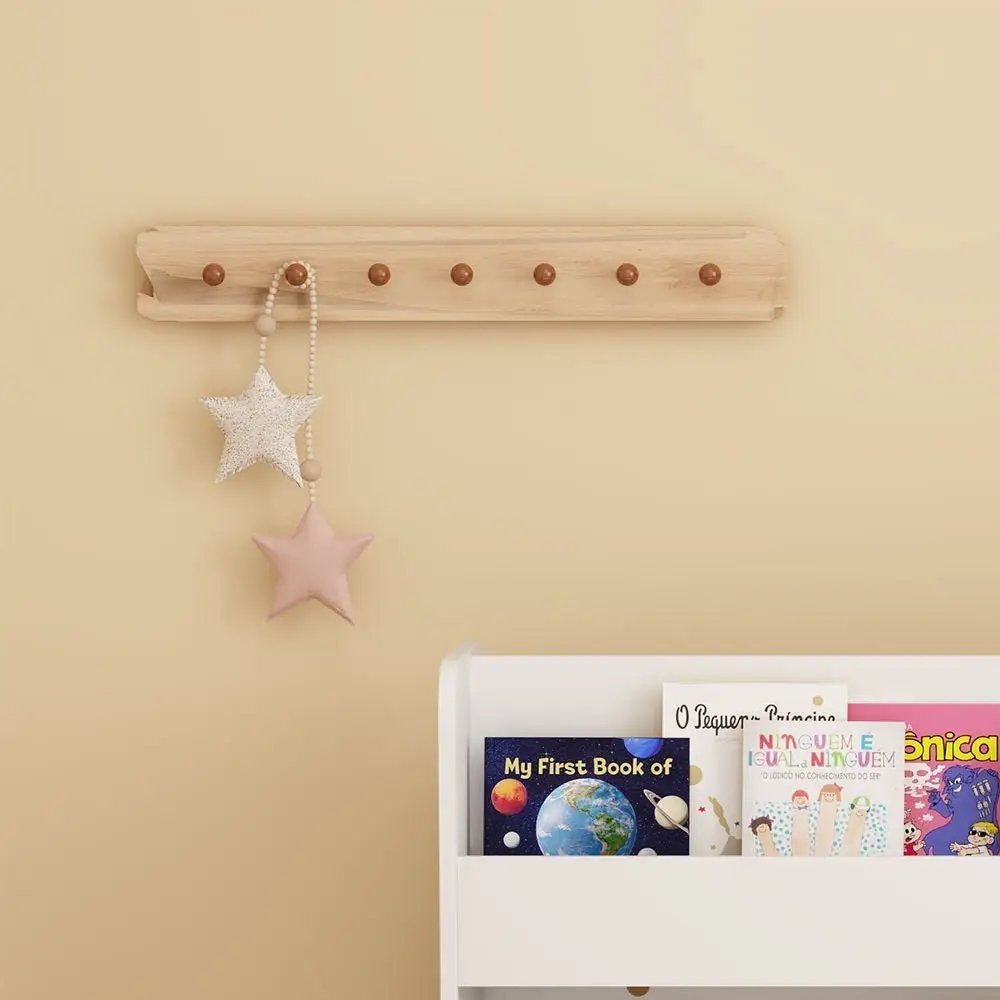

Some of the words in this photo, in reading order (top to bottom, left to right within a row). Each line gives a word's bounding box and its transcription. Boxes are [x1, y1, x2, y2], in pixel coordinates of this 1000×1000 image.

[675, 704, 689, 729] O
[904, 731, 999, 762] ônica
[504, 757, 532, 780] My
[537, 757, 588, 776] First
[593, 757, 645, 776] Book
[650, 757, 673, 776] of
